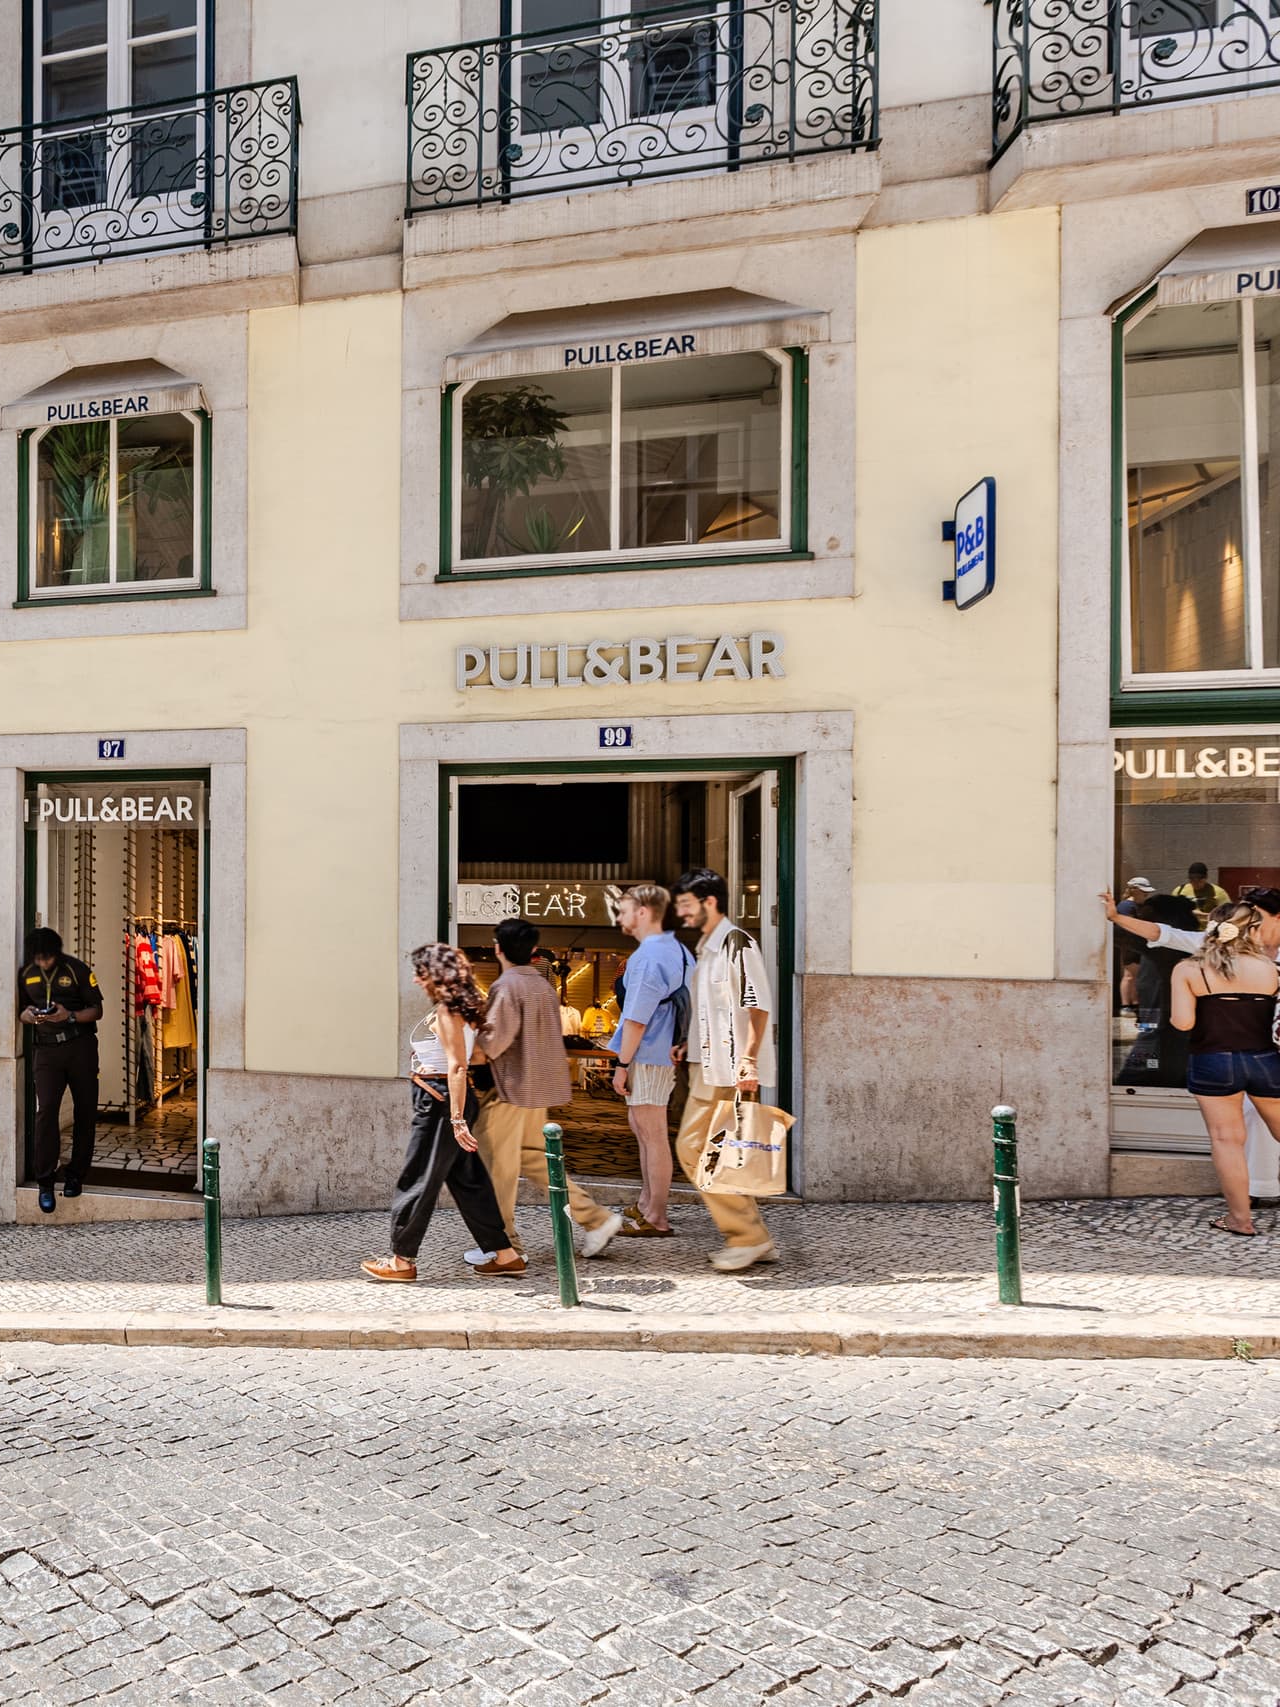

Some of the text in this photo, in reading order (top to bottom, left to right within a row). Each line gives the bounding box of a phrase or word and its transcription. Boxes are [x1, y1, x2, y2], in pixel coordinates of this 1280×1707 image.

[564, 334, 696, 367] PULL&BEAR
[47, 395, 149, 421] PULL&BEAR
[956, 515, 985, 562] P&B
[456, 631, 786, 690] PULL&BEAR
[102, 740, 121, 758] 97
[603, 727, 627, 746] 99
[39, 796, 194, 823] PULL&BEAR
[458, 891, 587, 919] L&BEAR
